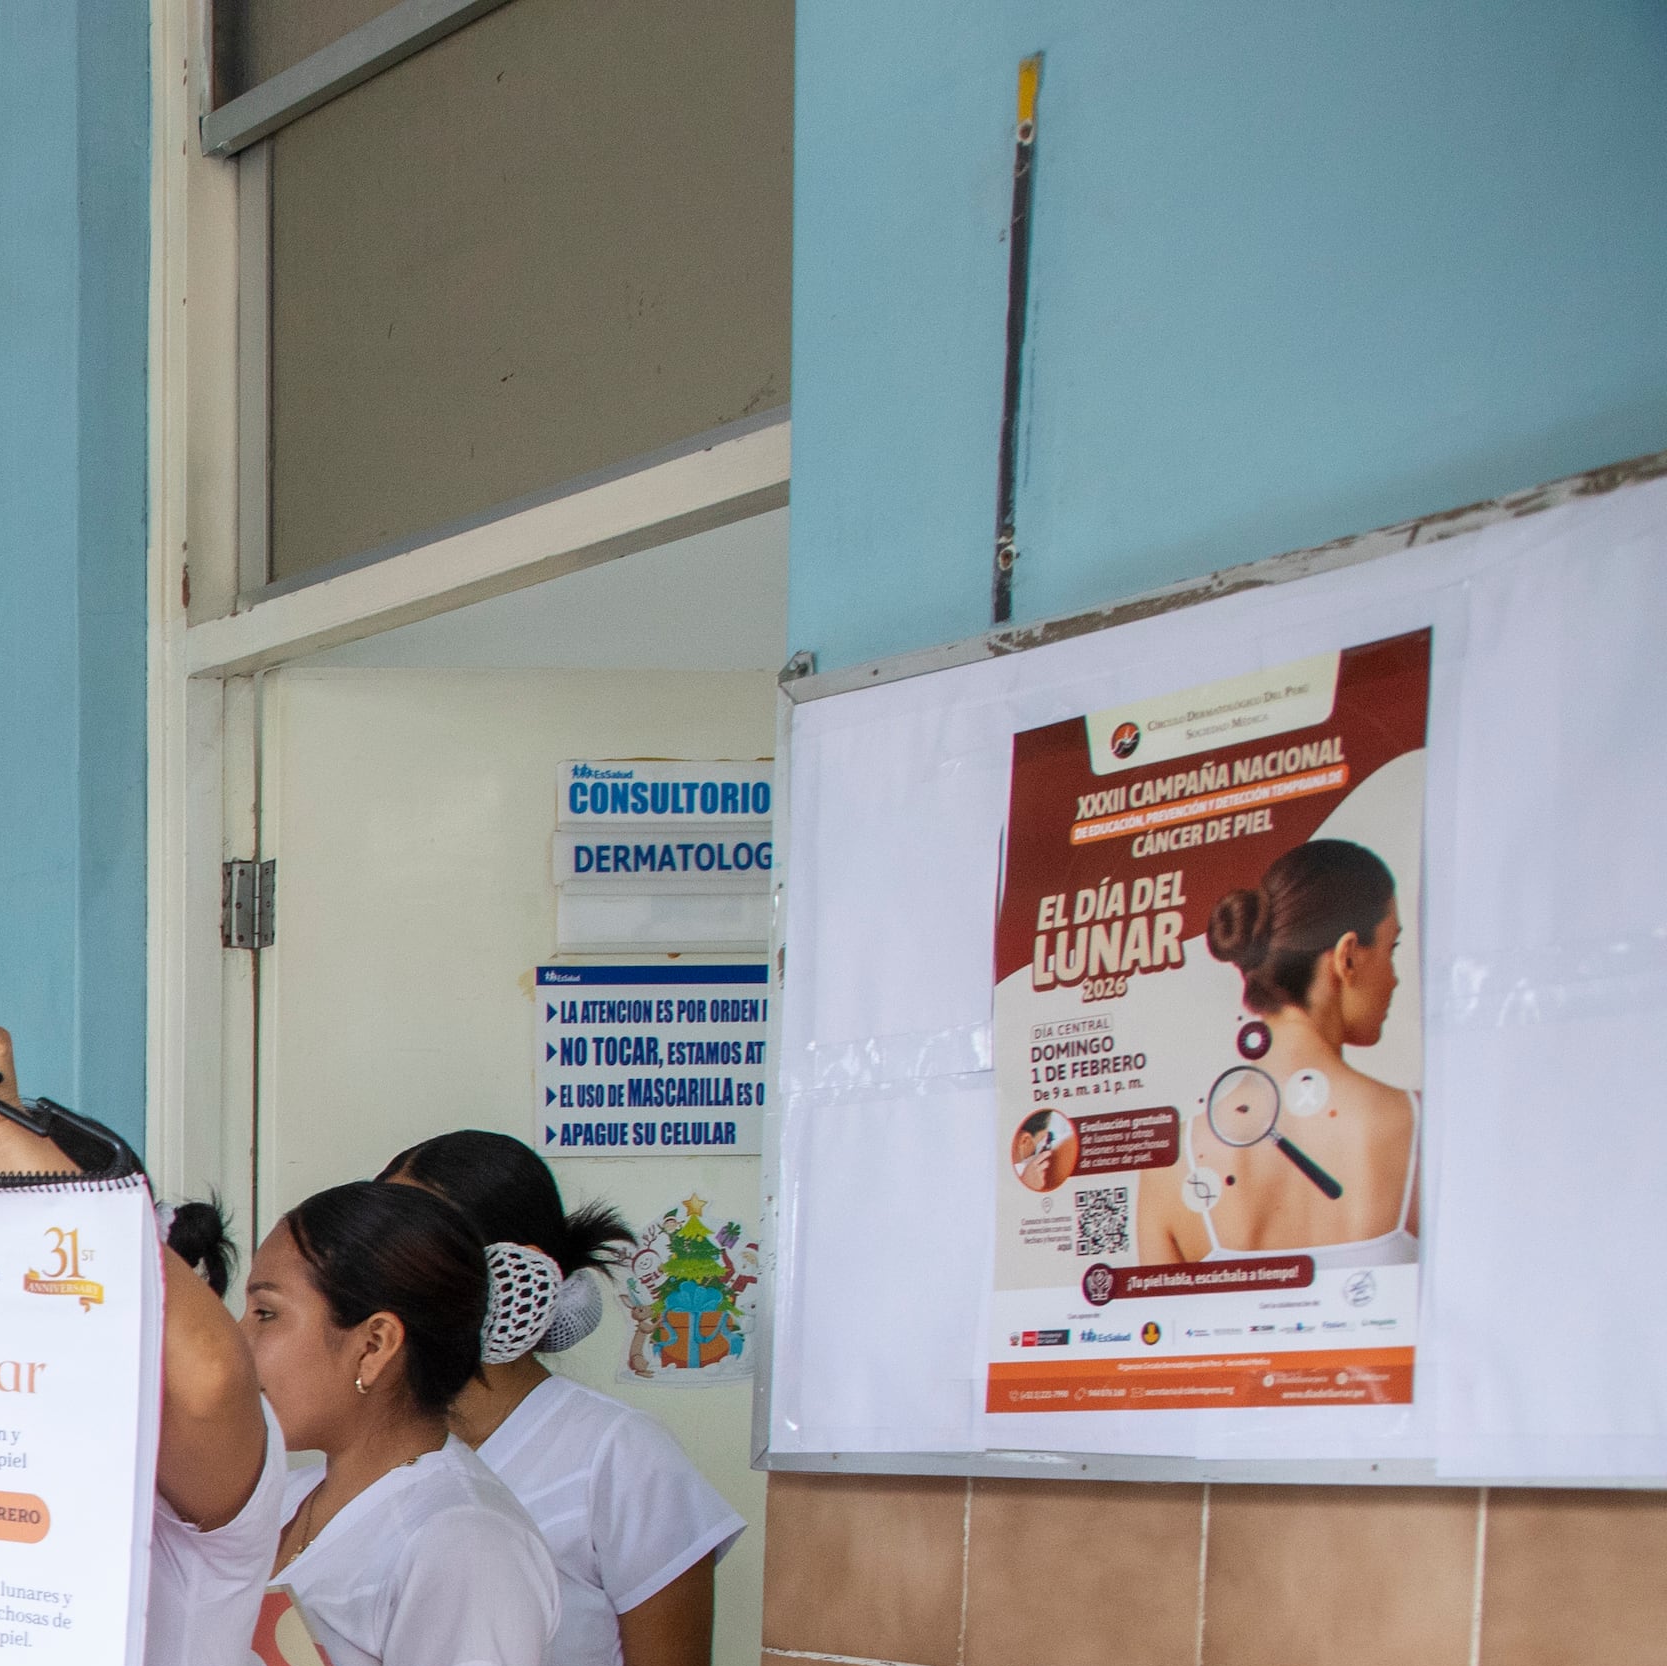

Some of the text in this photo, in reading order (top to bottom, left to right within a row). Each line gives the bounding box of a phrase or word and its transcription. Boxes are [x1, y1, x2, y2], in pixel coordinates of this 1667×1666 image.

[594, 770, 633, 779] EsSalud
[1075, 737, 1345, 820] XXXII CAMPAÑA NACIONAL
[569, 781, 771, 814] CONSULTORIO
[1131, 808, 1273, 858] CÁNCER DE PIEL
[1037, 870, 1186, 931] EL DÍA DEL
[1033, 911, 1184, 988] LUNAR
[1082, 976, 1127, 1002] 2026
[560, 1000, 578, 1024] LA
[580, 1000, 652, 1024] ATENCION
[656, 999, 673, 1023] ES
[676, 999, 706, 1023] POR
[710, 999, 758, 1023] ORDEN
[1057, 1019, 1110, 1036] CENTRAL
[560, 1037, 588, 1066] NO
[592, 1036, 663, 1068] TOCAR,
[667, 1041, 741, 1065] ESTAMOS
[1031, 1036, 1114, 1063] DOMINGO
[1031, 1053, 1147, 1084] 1 DE FEBRERO
[560, 1084, 574, 1108] EL
[577, 1084, 604, 1108] USO
[607, 1084, 624, 1107] DE
[627, 1077, 733, 1107] MASCARILLA
[736, 1082, 753, 1106] ES
[560, 1121, 736, 1146] APAGUE SU CELULAR
[27, 1281, 99, 1295] ANNIVERSARY
[1143, 1274, 1162, 1290] piel
[1257, 1266, 1300, 1282] tiempo!
[11, 1430, 20, 1446] y
[0, 1580, 60, 1604] lunares
[62, 1593, 73, 1608] y
[52, 1612, 72, 1630] de
[0, 1629, 33, 1648] piel.
